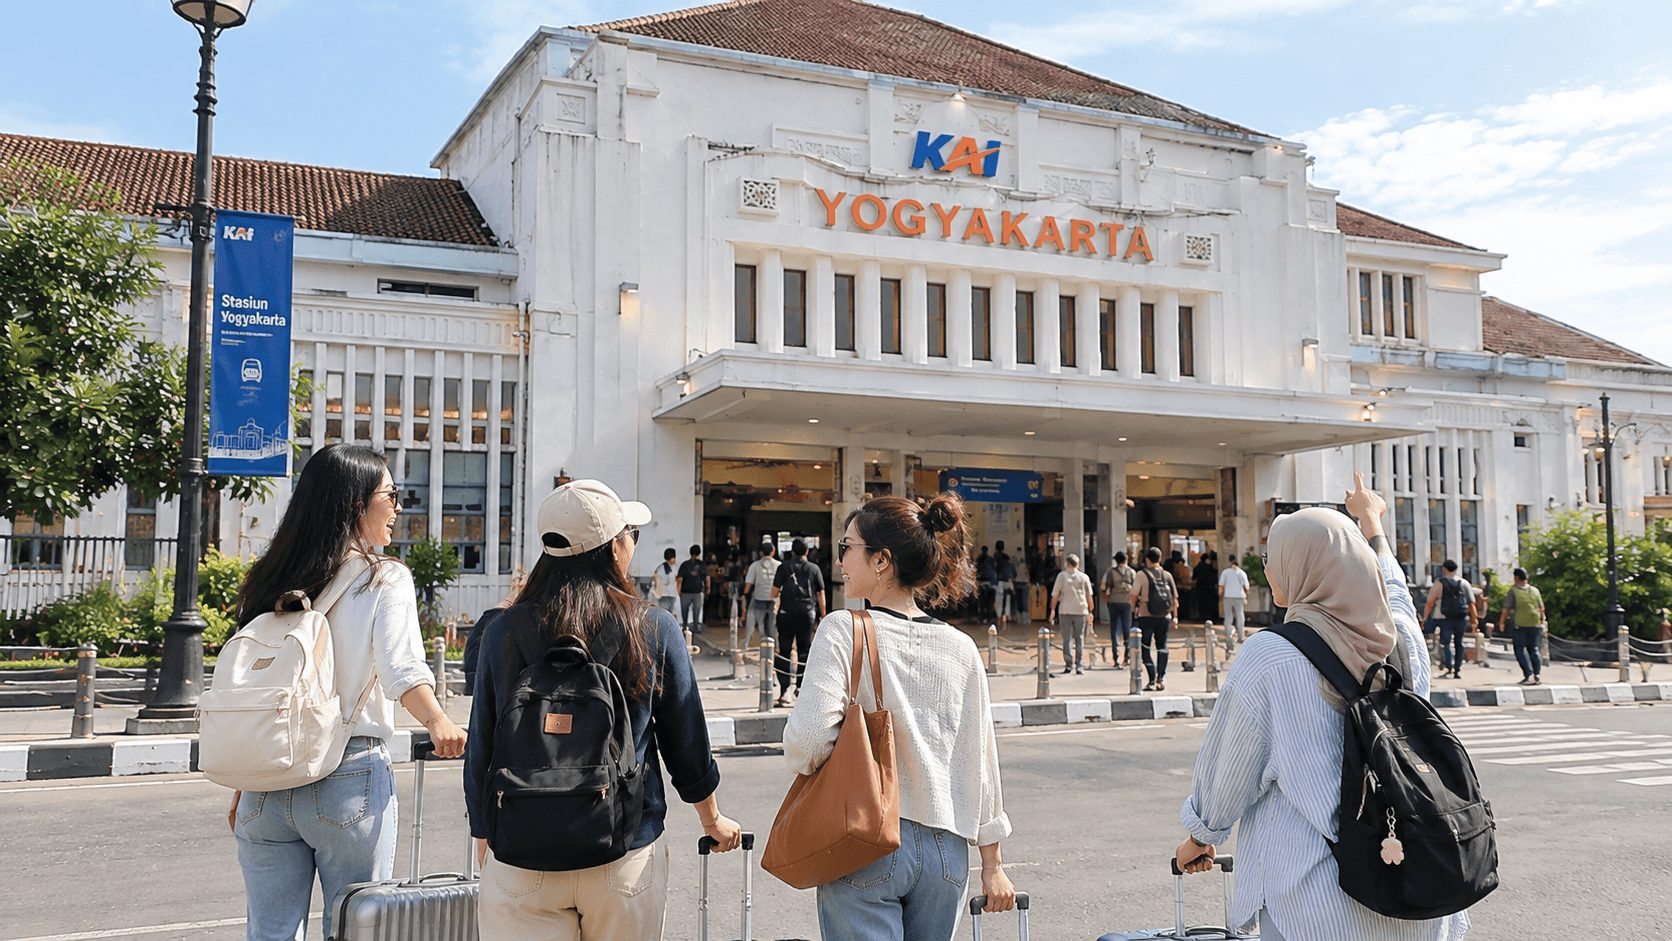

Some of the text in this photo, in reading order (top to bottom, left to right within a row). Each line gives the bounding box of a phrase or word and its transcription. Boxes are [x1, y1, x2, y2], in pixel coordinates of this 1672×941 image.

[911, 131, 1001, 177] KAI
[815, 188, 1154, 261] YOGYAKARTA
[221, 294, 268, 310] Stasiun
[221, 310, 286, 327] Yogyakarta
